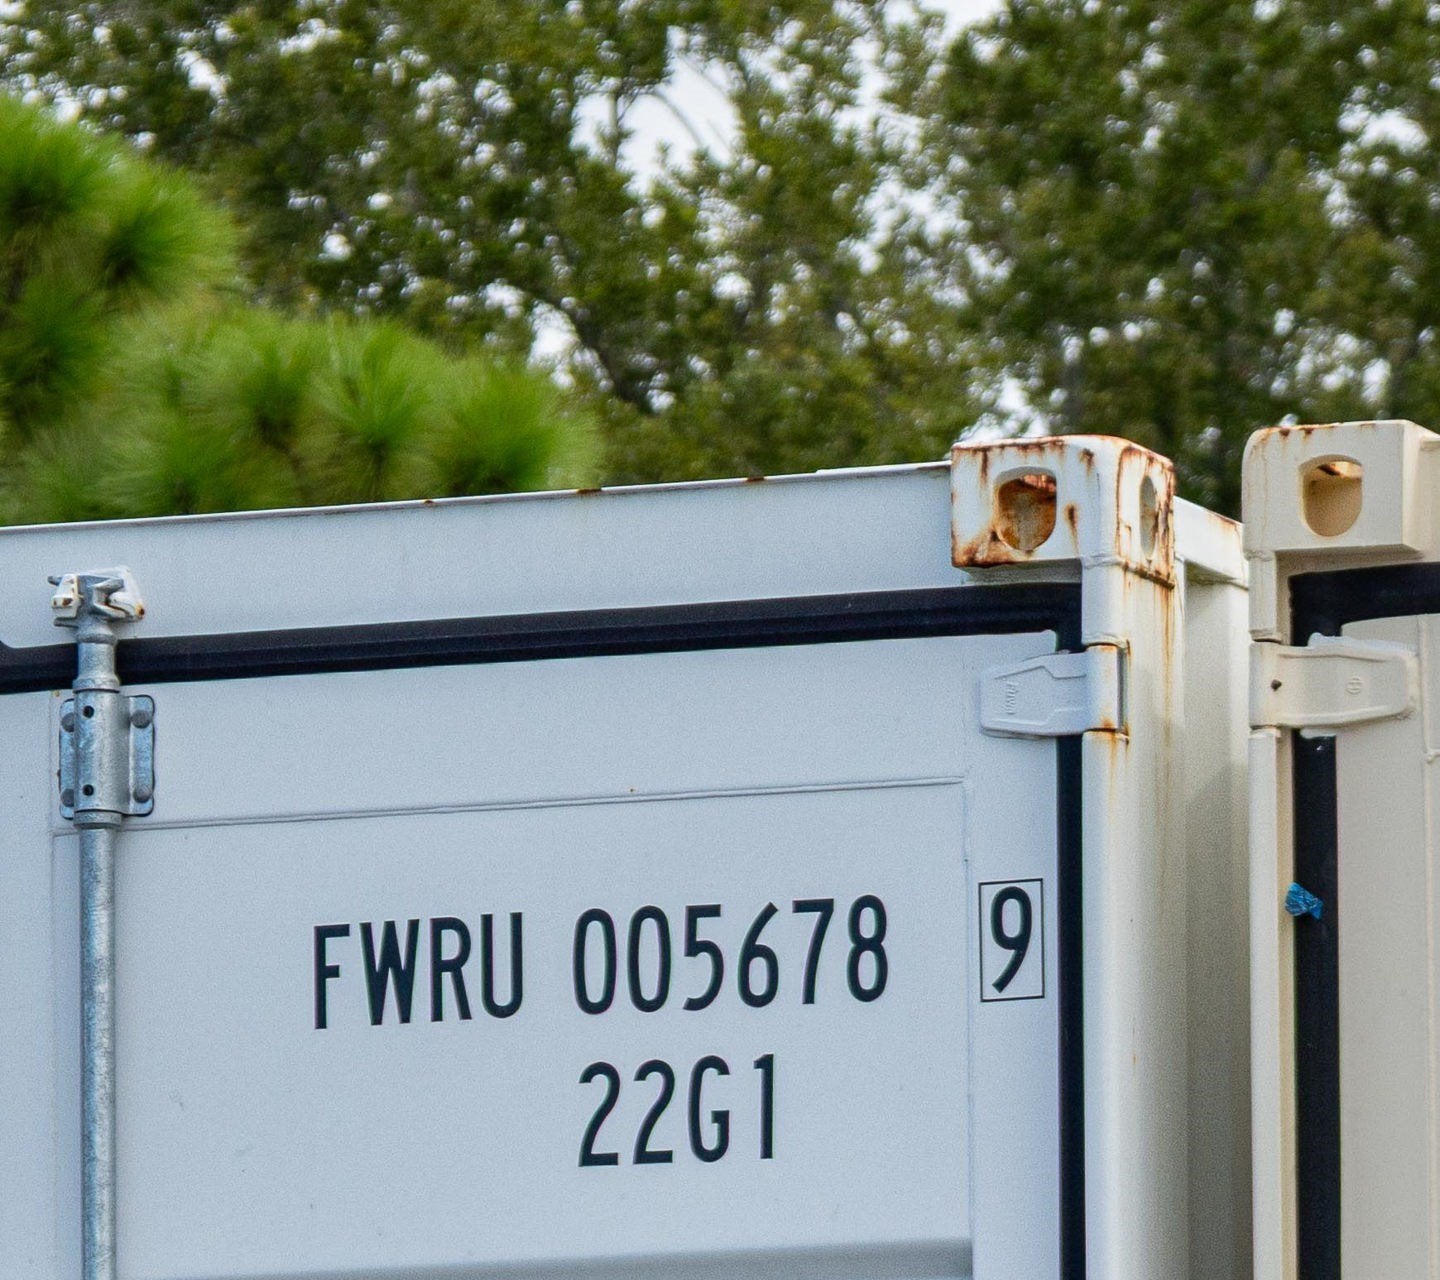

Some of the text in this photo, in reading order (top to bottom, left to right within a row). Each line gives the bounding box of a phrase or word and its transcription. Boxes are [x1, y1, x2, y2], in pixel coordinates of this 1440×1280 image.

[314, 885, 1034, 1030] FWRU 005678 9
[578, 1052, 775, 1168] 22G1
